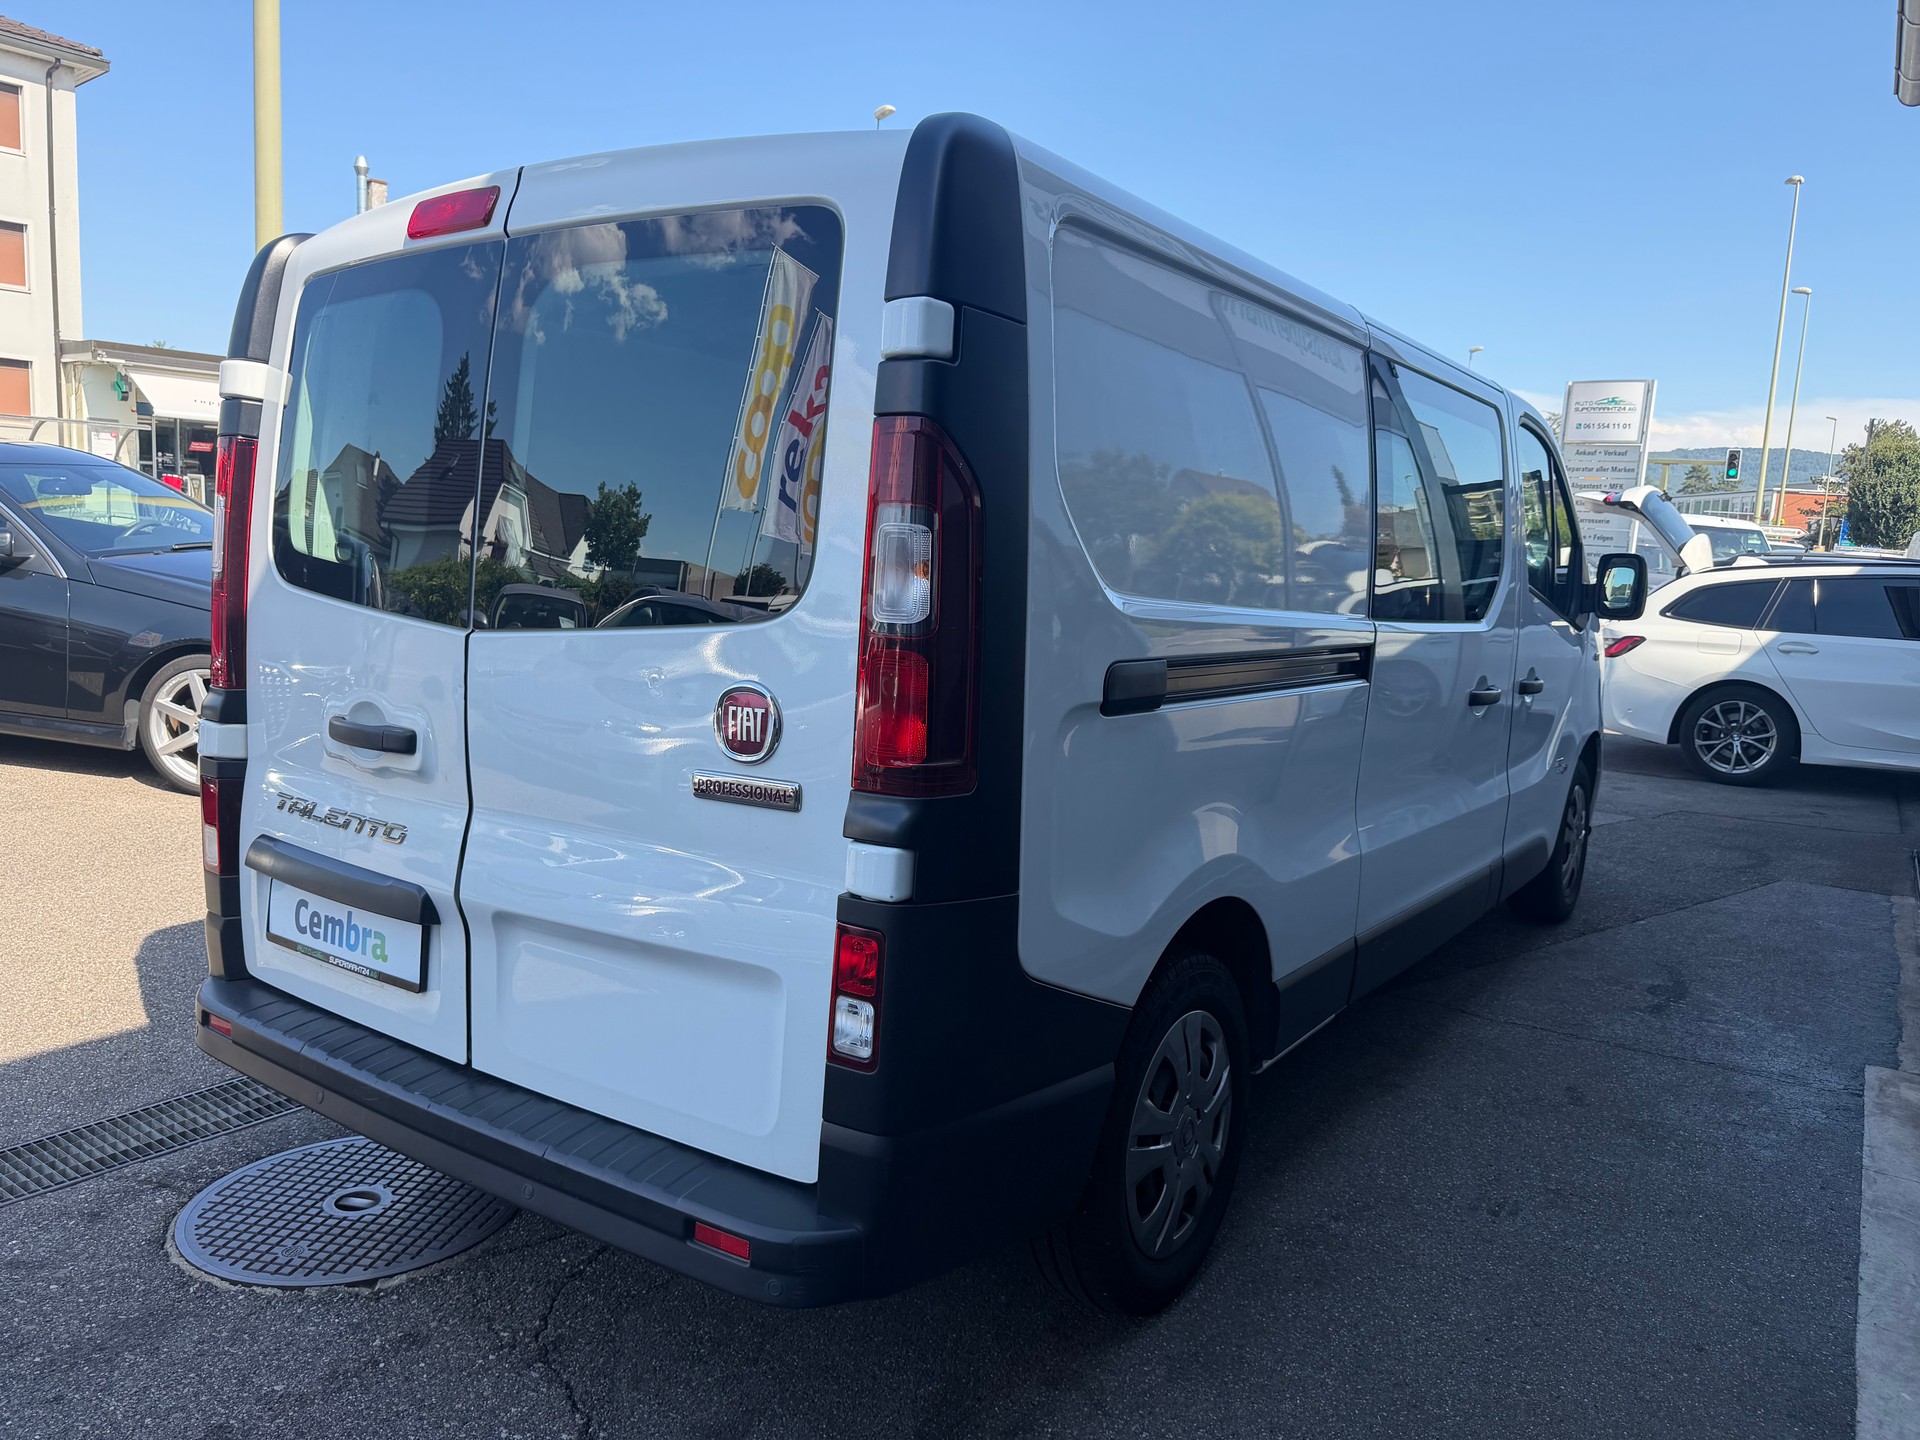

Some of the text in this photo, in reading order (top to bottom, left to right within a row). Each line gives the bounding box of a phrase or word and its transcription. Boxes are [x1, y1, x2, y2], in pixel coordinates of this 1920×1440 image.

[736, 304, 795, 500] coop
[1577, 516, 1610, 524] arrosserie
[1592, 533, 1614, 542] Felgen
[728, 705, 765, 742] FIAT
[697, 778, 790, 804] PROFESSIONAL
[276, 791, 409, 844] TALENTO
[294, 898, 388, 963] Cembra
